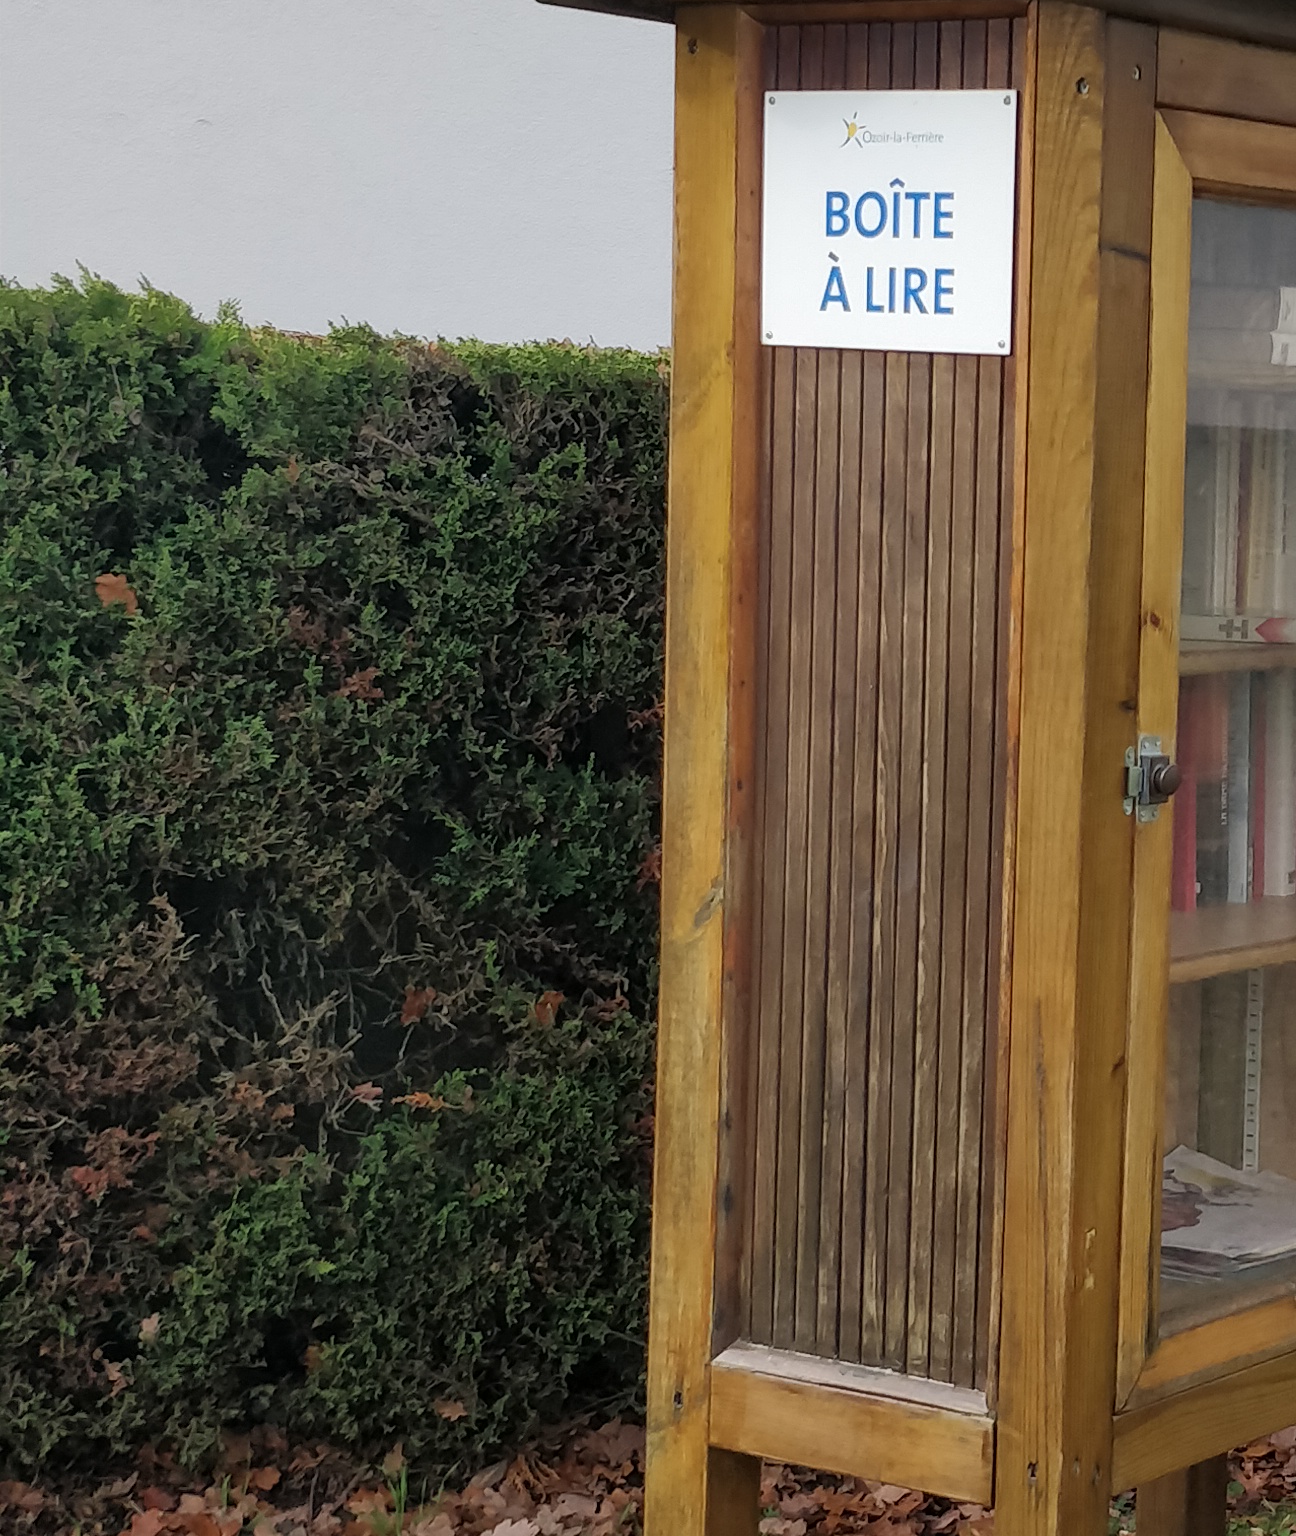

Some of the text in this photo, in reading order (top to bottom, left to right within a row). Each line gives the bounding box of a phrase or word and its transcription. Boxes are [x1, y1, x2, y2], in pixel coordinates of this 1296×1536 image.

[862, 129, 944, 144] Ozoir-la-Ferrière
[825, 178, 955, 239] BOÎTE
[819, 251, 955, 315] À LIRE
